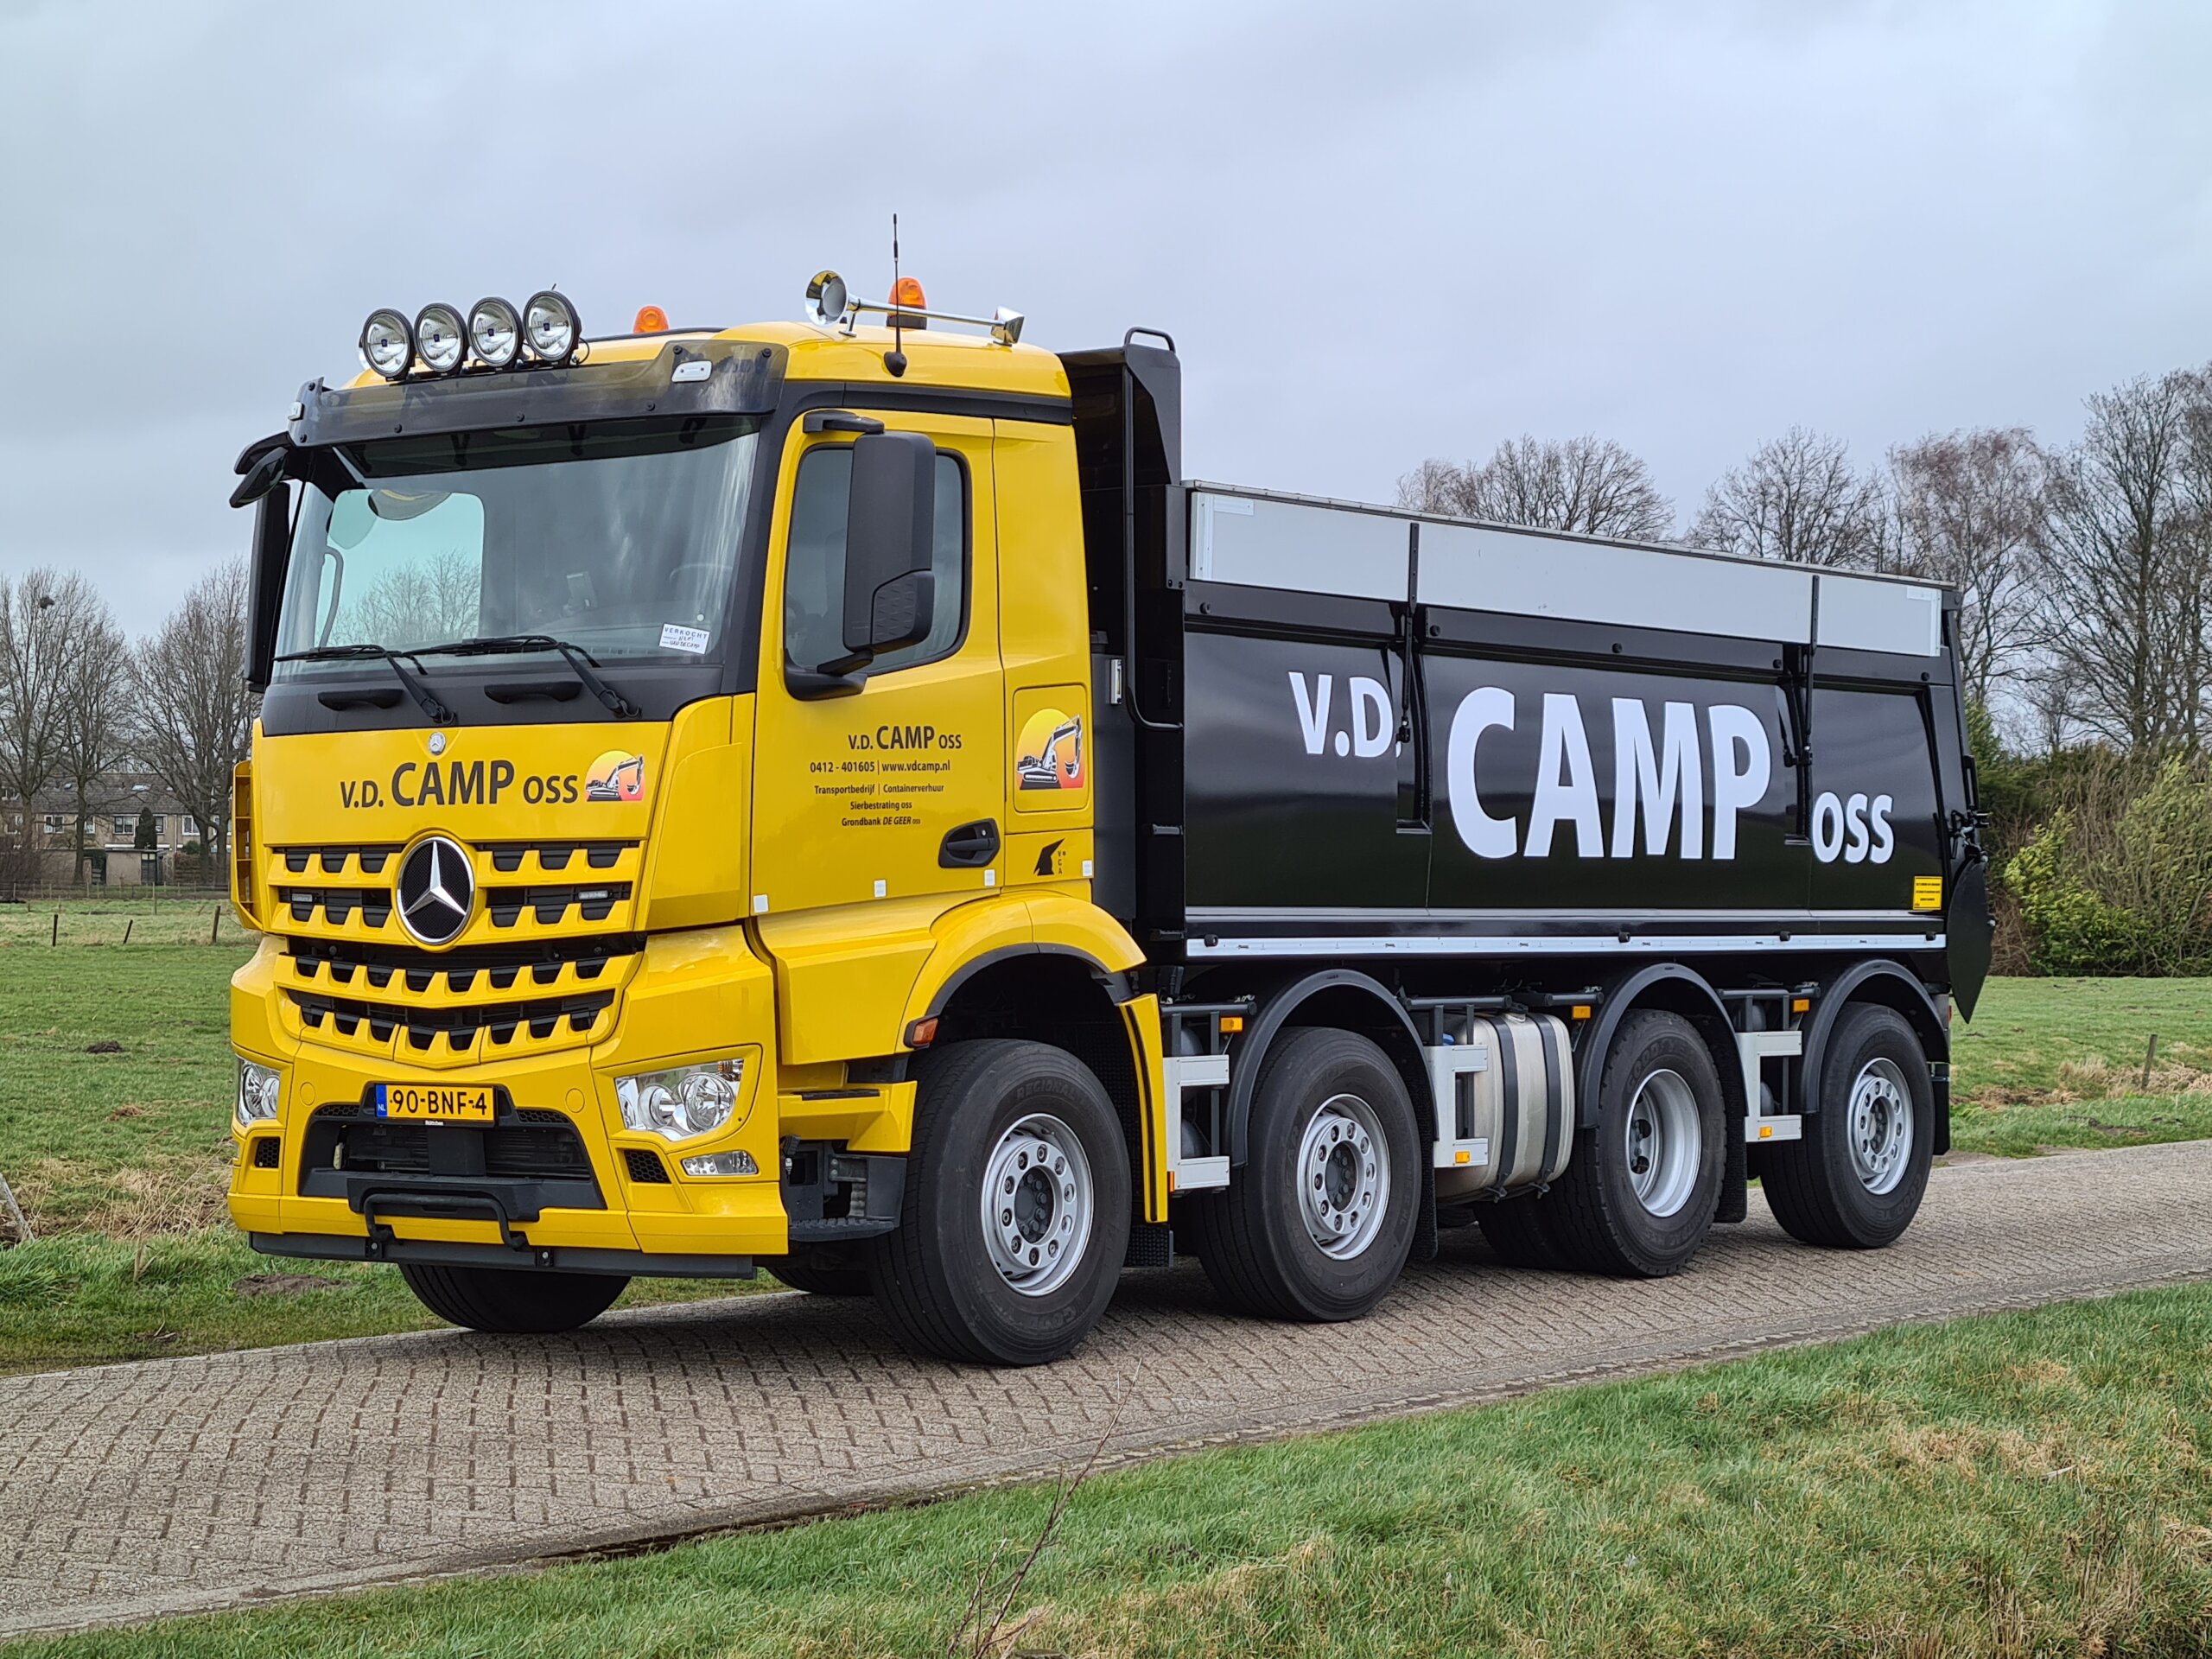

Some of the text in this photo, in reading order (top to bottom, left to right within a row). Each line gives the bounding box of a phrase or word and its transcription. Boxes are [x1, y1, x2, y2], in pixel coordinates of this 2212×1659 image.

[664, 626, 708, 639] VERKOCHT
[848, 734, 874, 750] V.D.
[876, 725, 935, 750] CAMP
[810, 761, 834, 773] 0412
[841, 760, 875, 772] 401605
[881, 759, 950, 774] www.vdcamp.nl
[1446, 686, 1772, 861] CAMP
[340, 780, 384, 808] V.D.
[391, 759, 515, 807] CAMP
[814, 784, 875, 796] Transportbedrijf
[882, 783, 944, 793] Containerverhuur
[850, 800, 899, 811] Sierbestrating
[842, 817, 880, 827] Grondbank
[883, 817, 893, 825] DE
[893, 816, 912, 825] GEER
[392, 1089, 487, 1116] 90-BNF-4
